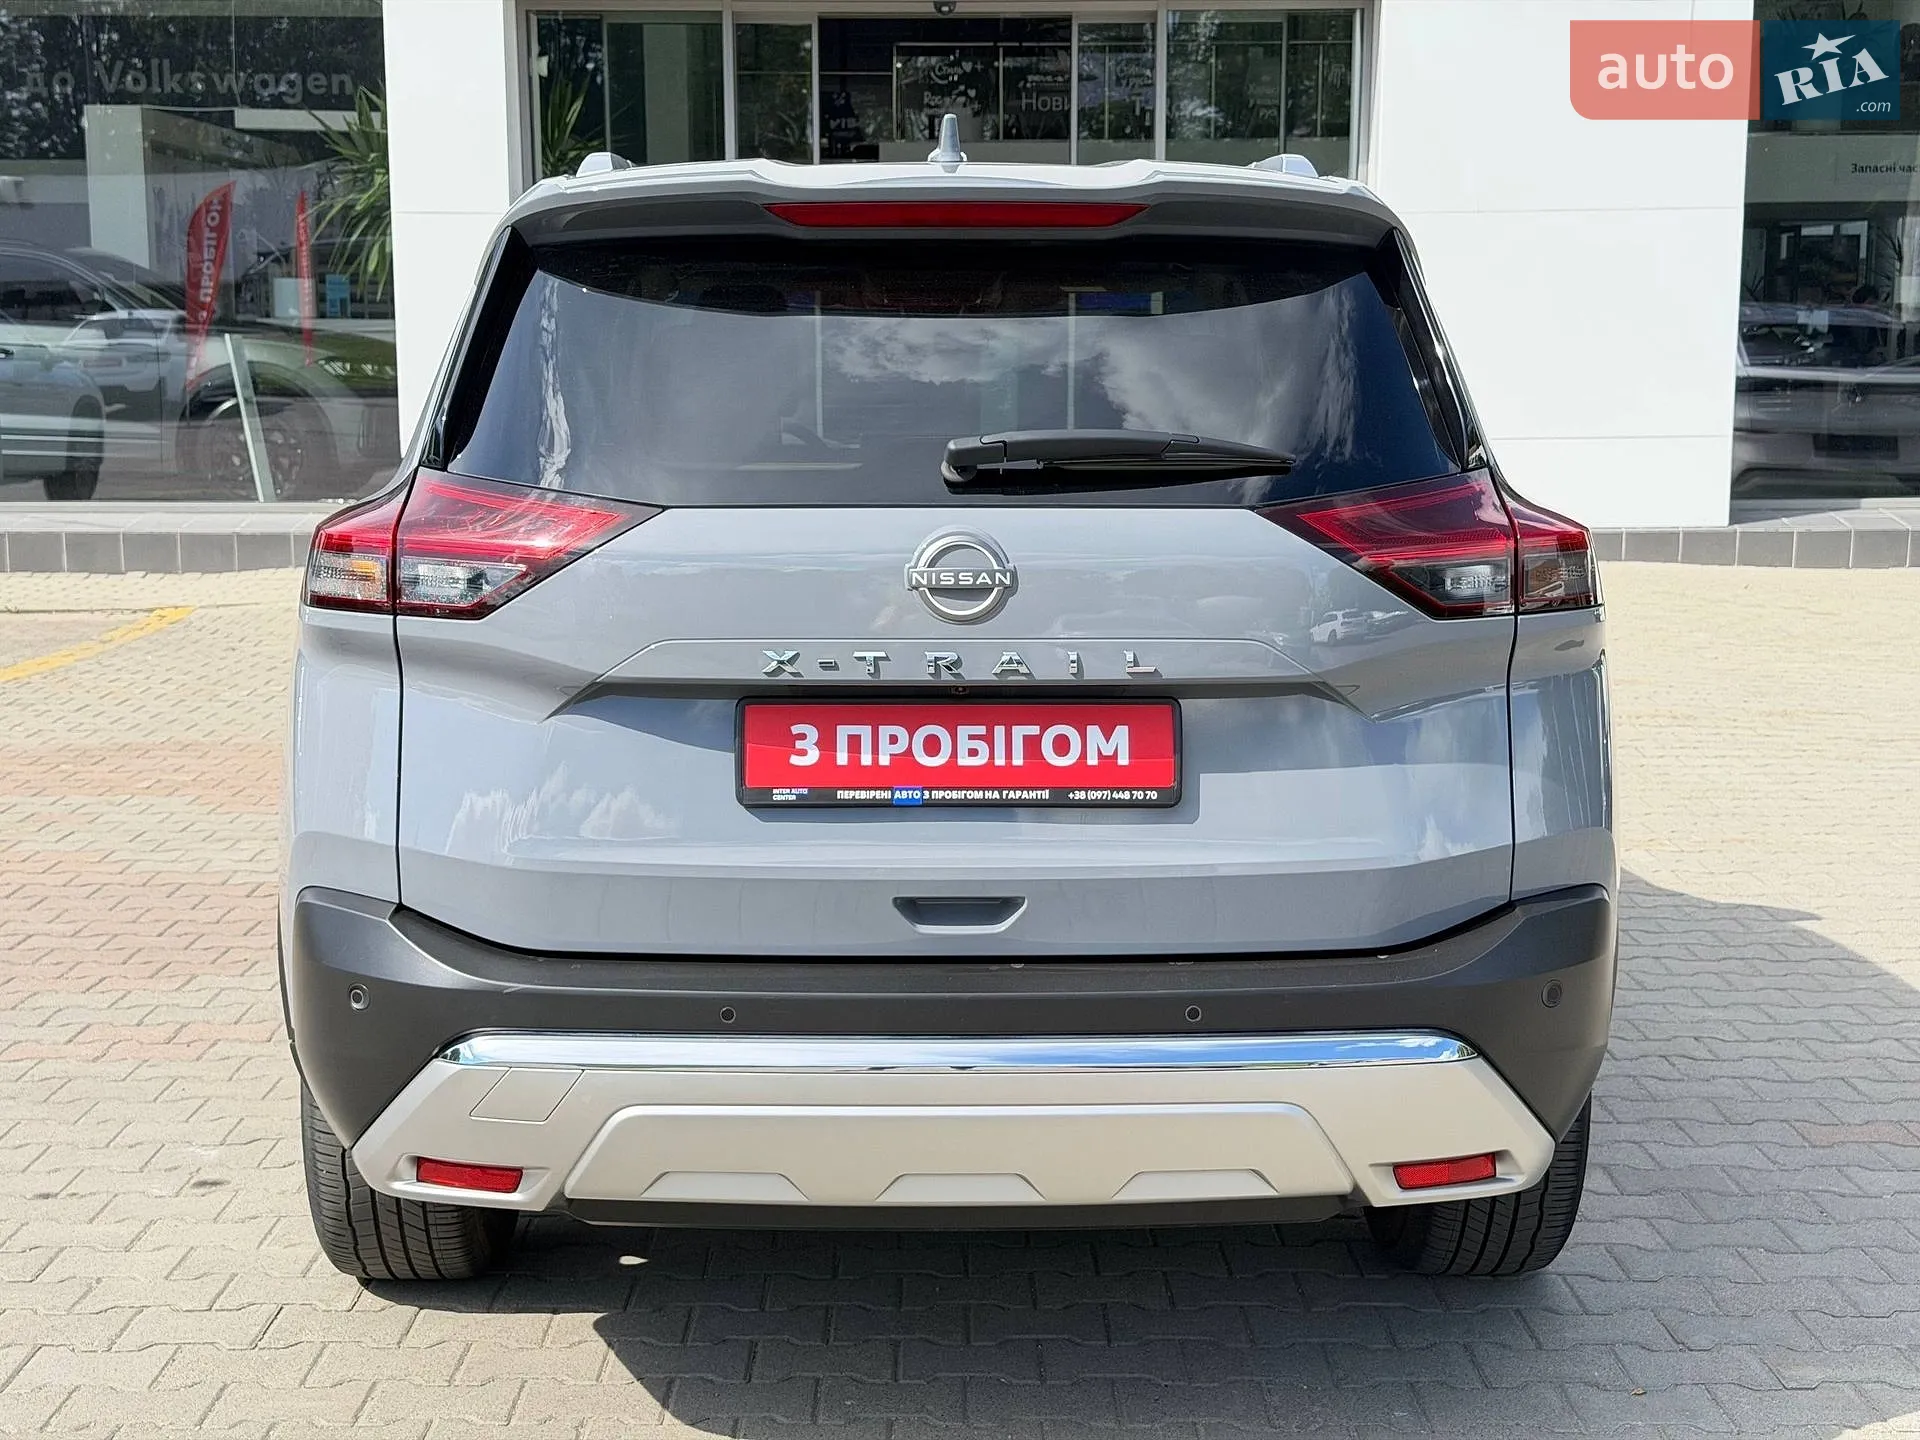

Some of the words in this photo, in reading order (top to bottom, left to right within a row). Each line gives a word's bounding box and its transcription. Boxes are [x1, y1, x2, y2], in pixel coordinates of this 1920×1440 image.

[98, 58, 353, 104] Volkswagen
[1850, 162, 1896, 174] Запасні
[911, 571, 1012, 586] NISSAN
[761, 649, 1158, 675] X-TRAIL
[788, 722, 820, 767] З
[835, 723, 1130, 767] ПРОБІГОМ
[836, 790, 892, 800] ПЕРЕВІРЕНІ
[893, 790, 921, 800] АВТО
[931, 790, 985, 800] ПРОБІГОМ
[985, 790, 1000, 800] НА
[1002, 788, 1050, 800] ГАРАНТІЇ
[1067, 790, 1086, 800] +38
[1087, 789, 1111, 801] (097)
[1112, 790, 1130, 800] 448
[1132, 790, 1144, 800] 70
[1145, 790, 1158, 800] 70
